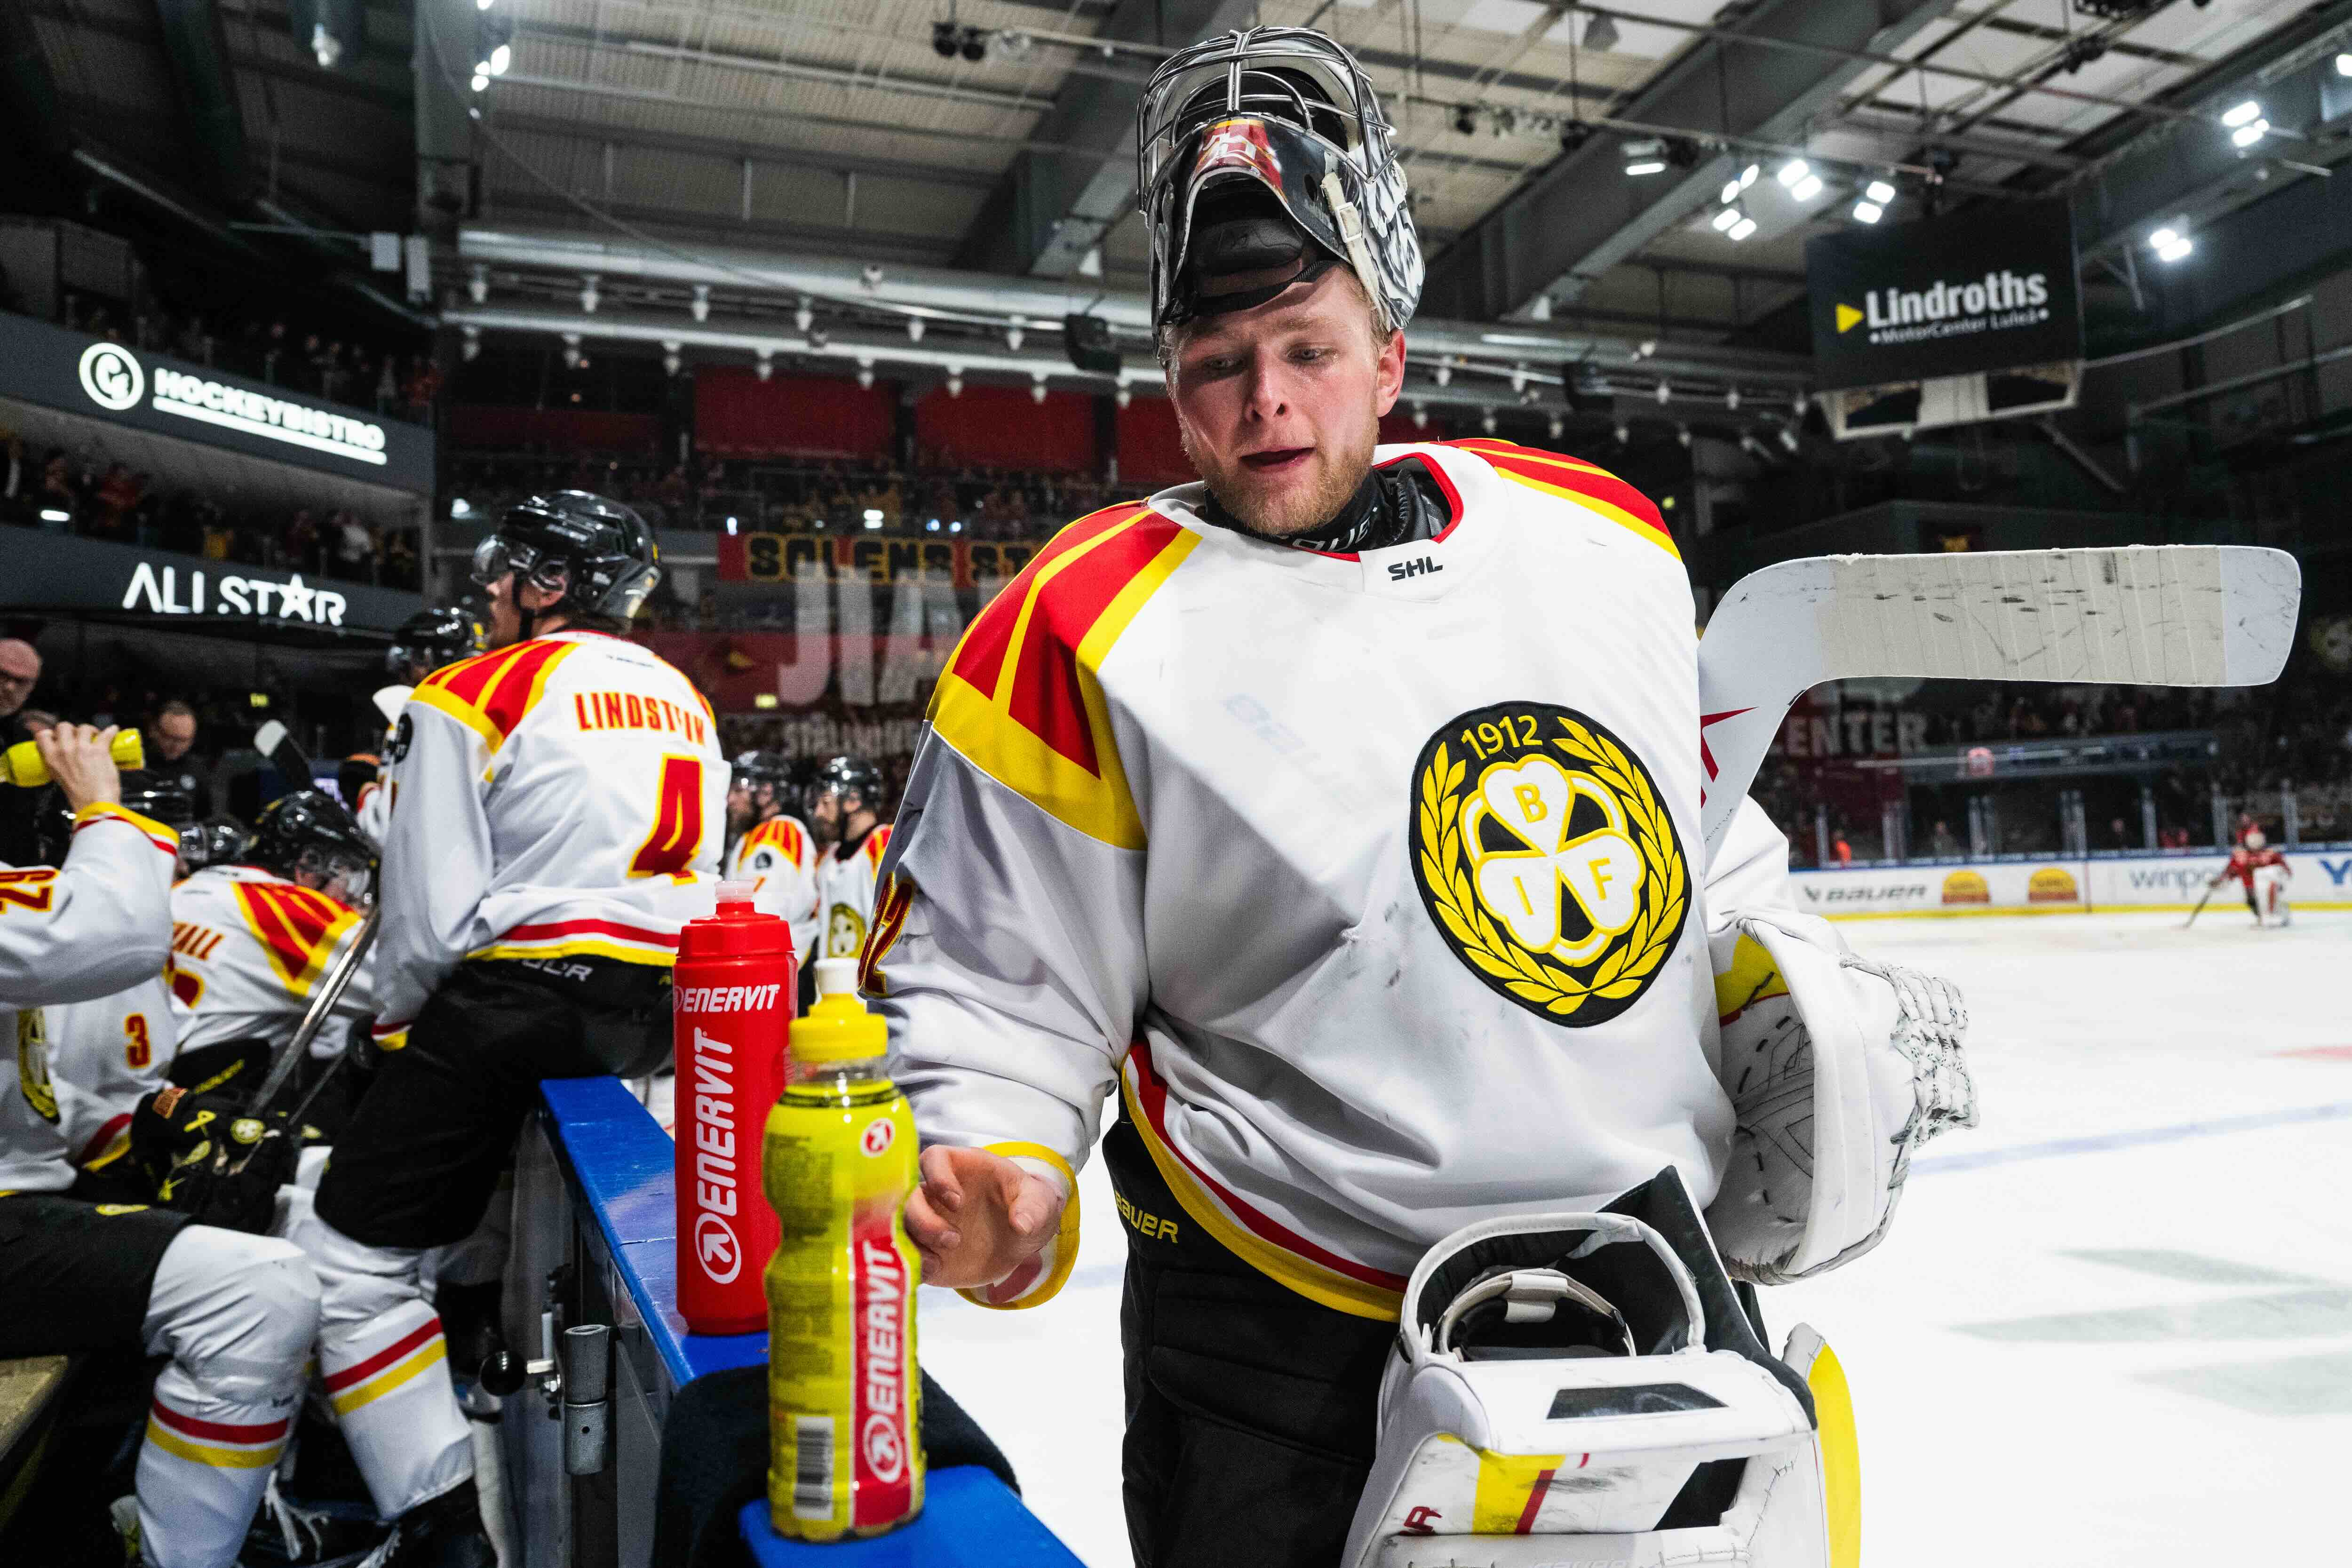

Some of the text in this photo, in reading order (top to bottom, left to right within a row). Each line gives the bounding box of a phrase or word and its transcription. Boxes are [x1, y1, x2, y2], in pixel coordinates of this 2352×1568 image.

[1866, 270, 2048, 328] Lindroths
[154, 367, 386, 451] HOCKEYBISTRO
[1388, 556, 1443, 581] SHL
[573, 692, 706, 747] LINDSTIN
[1462, 715, 1543, 761] 1912
[1770, 710, 1930, 756] ENTER
[1512, 782, 1548, 823] B
[1589, 857, 1613, 901] F
[2129, 867, 2218, 900] winpo
[682, 984, 780, 1012] ENERVIT
[124, 1013, 151, 1069] 3
[695, 1027, 738, 1217] ENERVIT
[862, 1239, 901, 1414] ENERVIT
